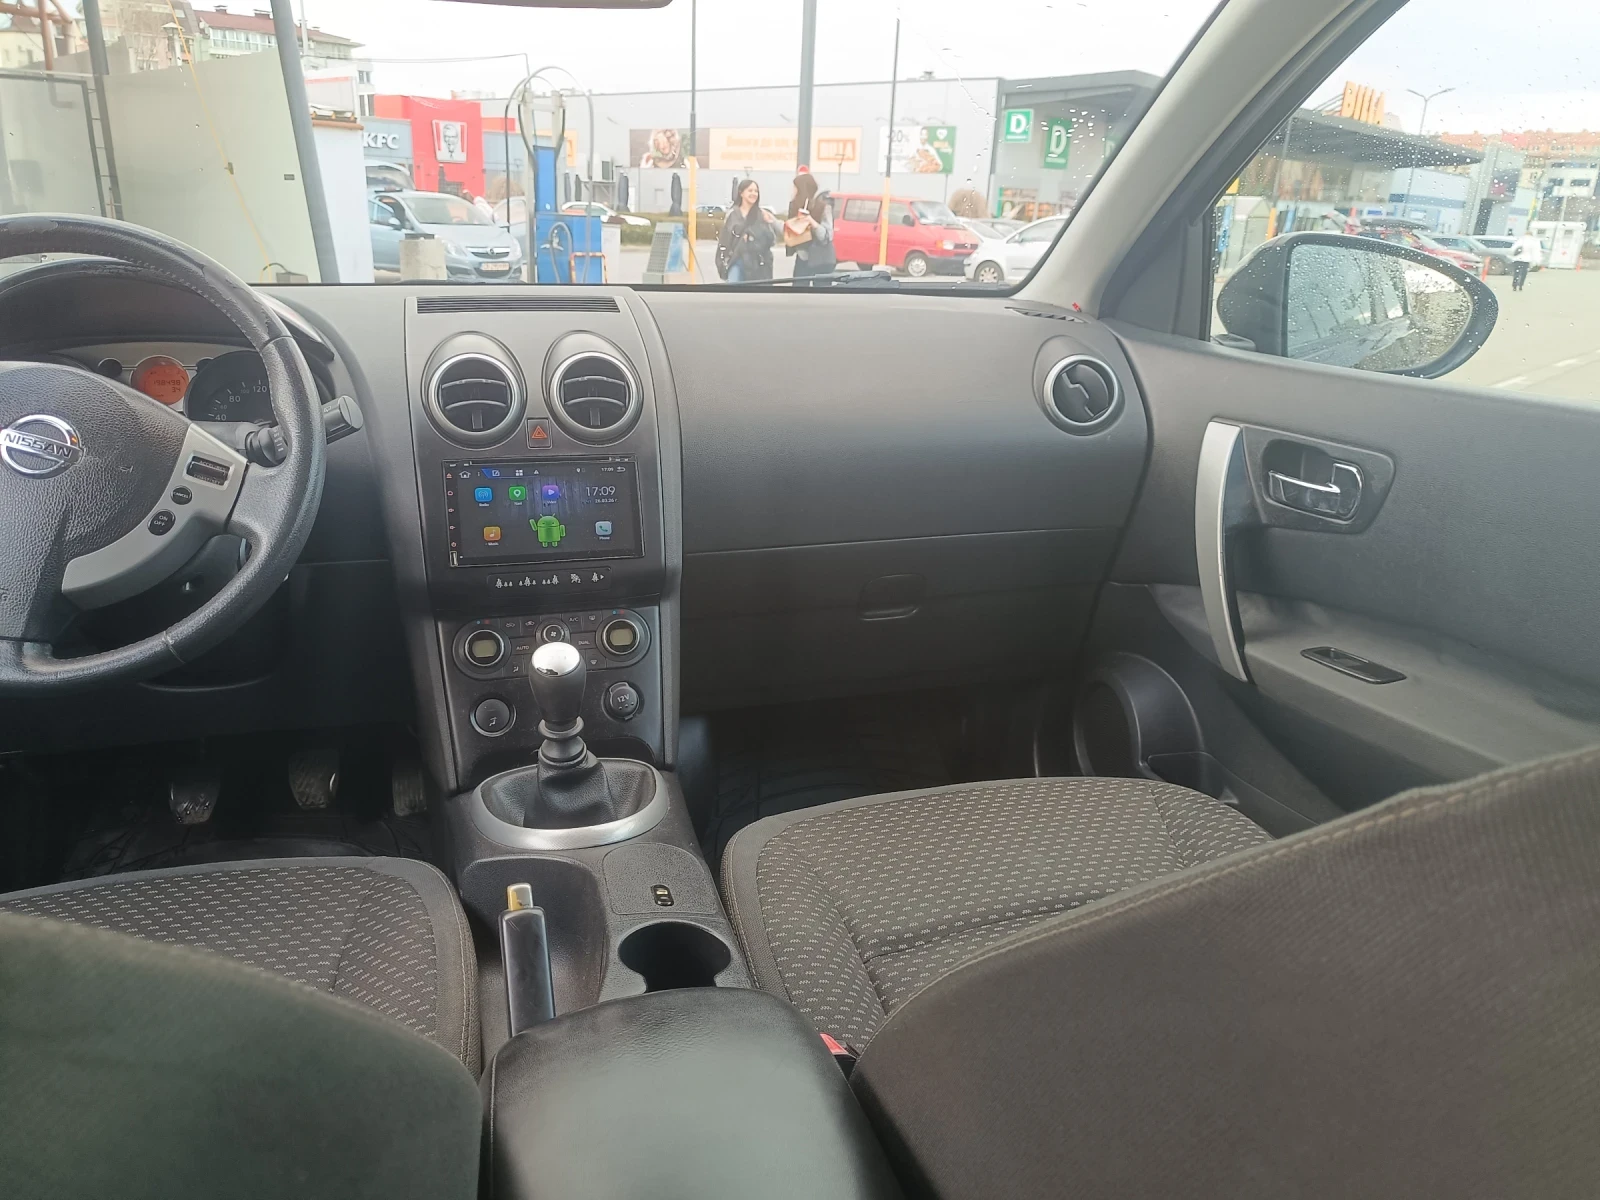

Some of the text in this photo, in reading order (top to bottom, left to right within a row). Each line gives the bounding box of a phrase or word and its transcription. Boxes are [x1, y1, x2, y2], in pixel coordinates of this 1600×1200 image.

[1010, 113, 1027, 134] D
[363, 132, 400, 149] KFC
[1049, 124, 1067, 156] D
[252, 385, 268, 393] 120
[3, 433, 73, 459] NISSAN
[586, 485, 616, 496] 17:09
[617, 693, 630, 703] 12V
